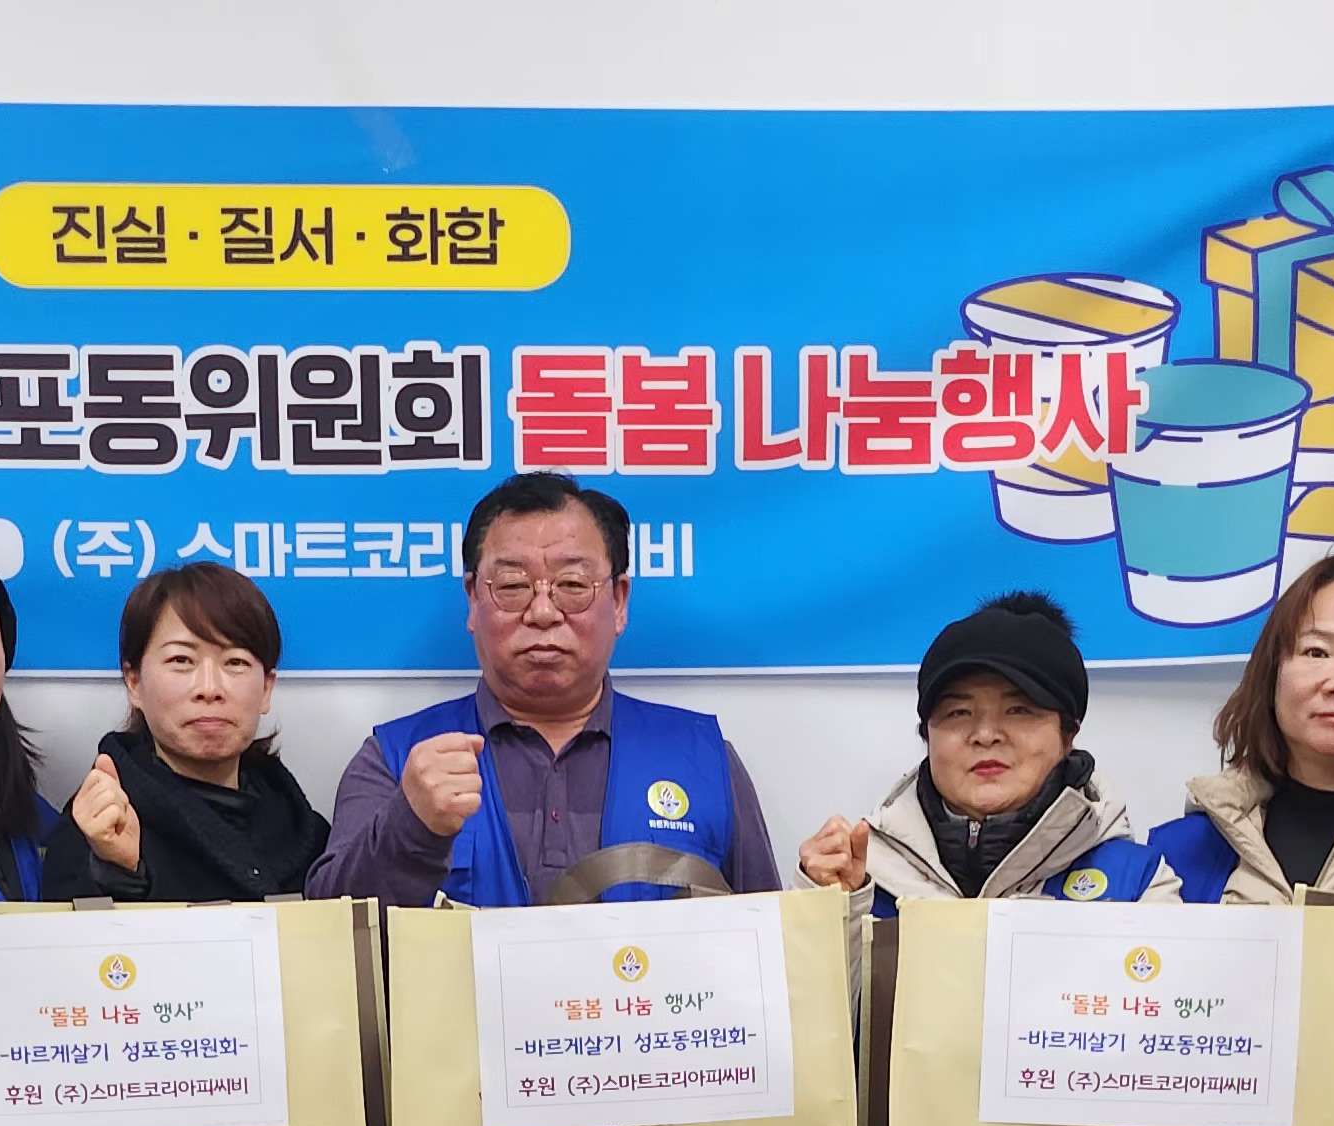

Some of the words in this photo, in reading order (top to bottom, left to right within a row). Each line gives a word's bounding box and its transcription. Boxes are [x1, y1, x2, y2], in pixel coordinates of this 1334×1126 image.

[50, 204, 168, 266] 진실
[218, 206, 335, 266] 질서
[385, 206, 506, 267] 화합
[510, 352, 715, 466] 돌봄
[740, 350, 1147, 466] 나눔행사
[53, 519, 157, 578] (주)
[177, 521, 695, 578] 스마트코리비
[101, 1004, 141, 1025] 나눔
[615, 995, 653, 1017] 나눔
[1122, 996, 1162, 1017] 나눔
[4, 1084, 43, 1106] 후원
[54, 1076, 249, 1106] (주)스마트코리아피씨비
[518, 1076, 556, 1098] 후원
[567, 1065, 756, 1097] (주)스마트코리아피씨비
[1018, 1067, 1055, 1090] 후원
[1067, 1070, 1258, 1095] (주)스마트코리아피씨비
